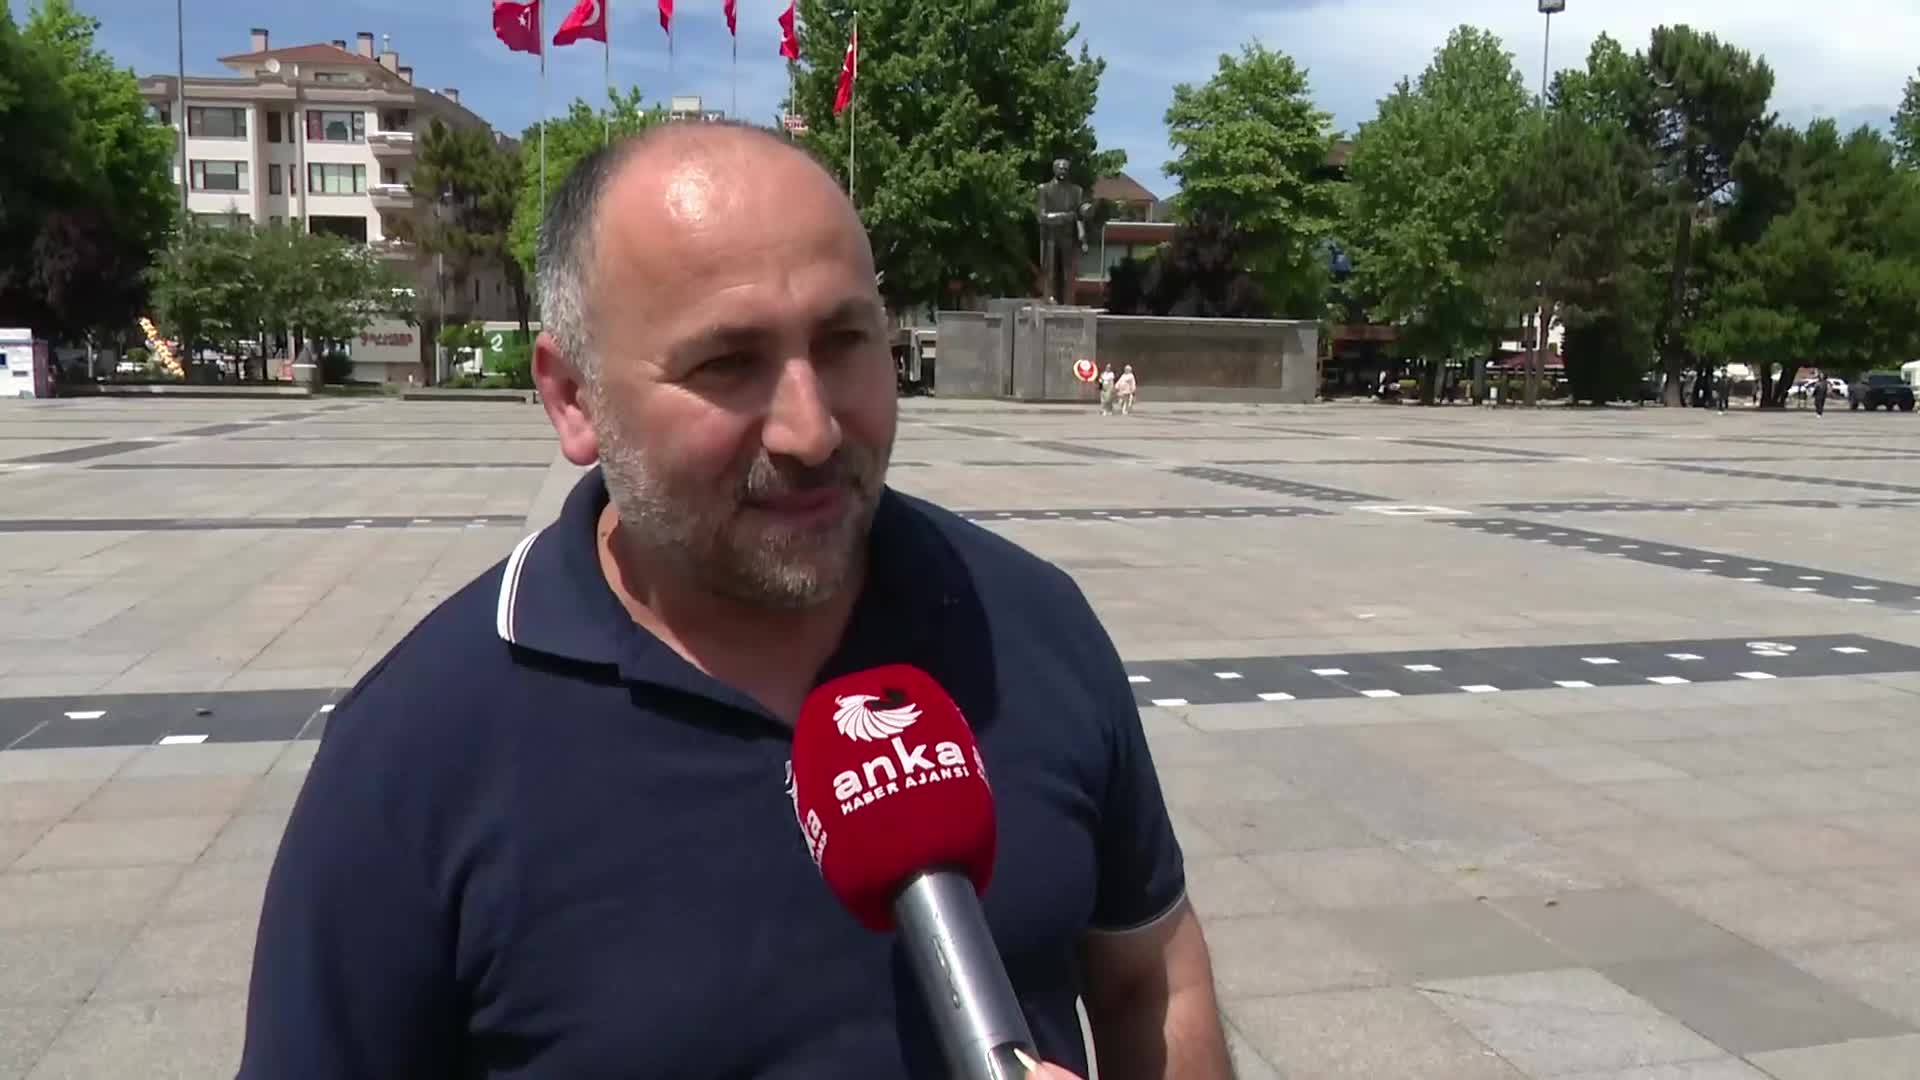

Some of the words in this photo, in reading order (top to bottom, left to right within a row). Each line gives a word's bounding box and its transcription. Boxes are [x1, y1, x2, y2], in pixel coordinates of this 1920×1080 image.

[832, 736, 967, 801] anka
[840, 783, 900, 816] HABER
[905, 766, 970, 789] AJANSI
